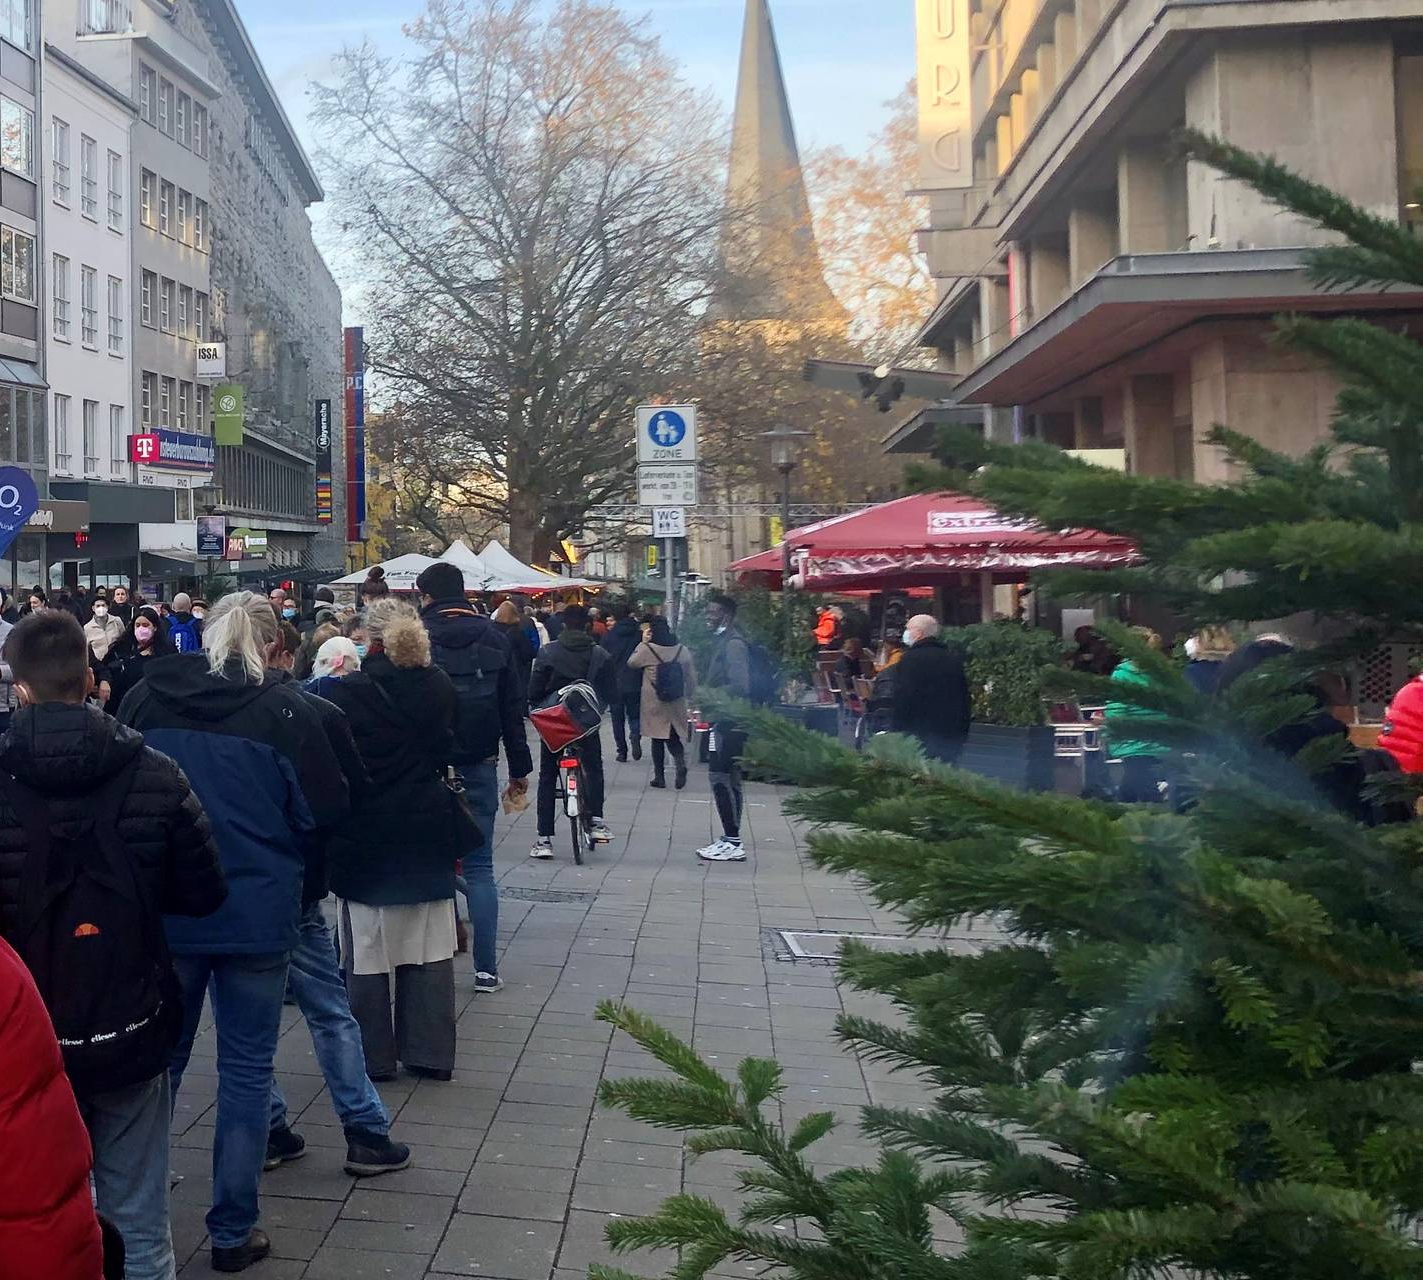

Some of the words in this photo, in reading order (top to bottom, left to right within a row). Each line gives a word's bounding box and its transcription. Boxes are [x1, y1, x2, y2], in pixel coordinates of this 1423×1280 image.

[198, 347, 218, 360] ISSA
[319, 403, 328, 445] Mayersche
[652, 449, 682, 459] ZONE
[657, 510, 680, 520] WC
[90, 1031, 117, 1043] ellesse
